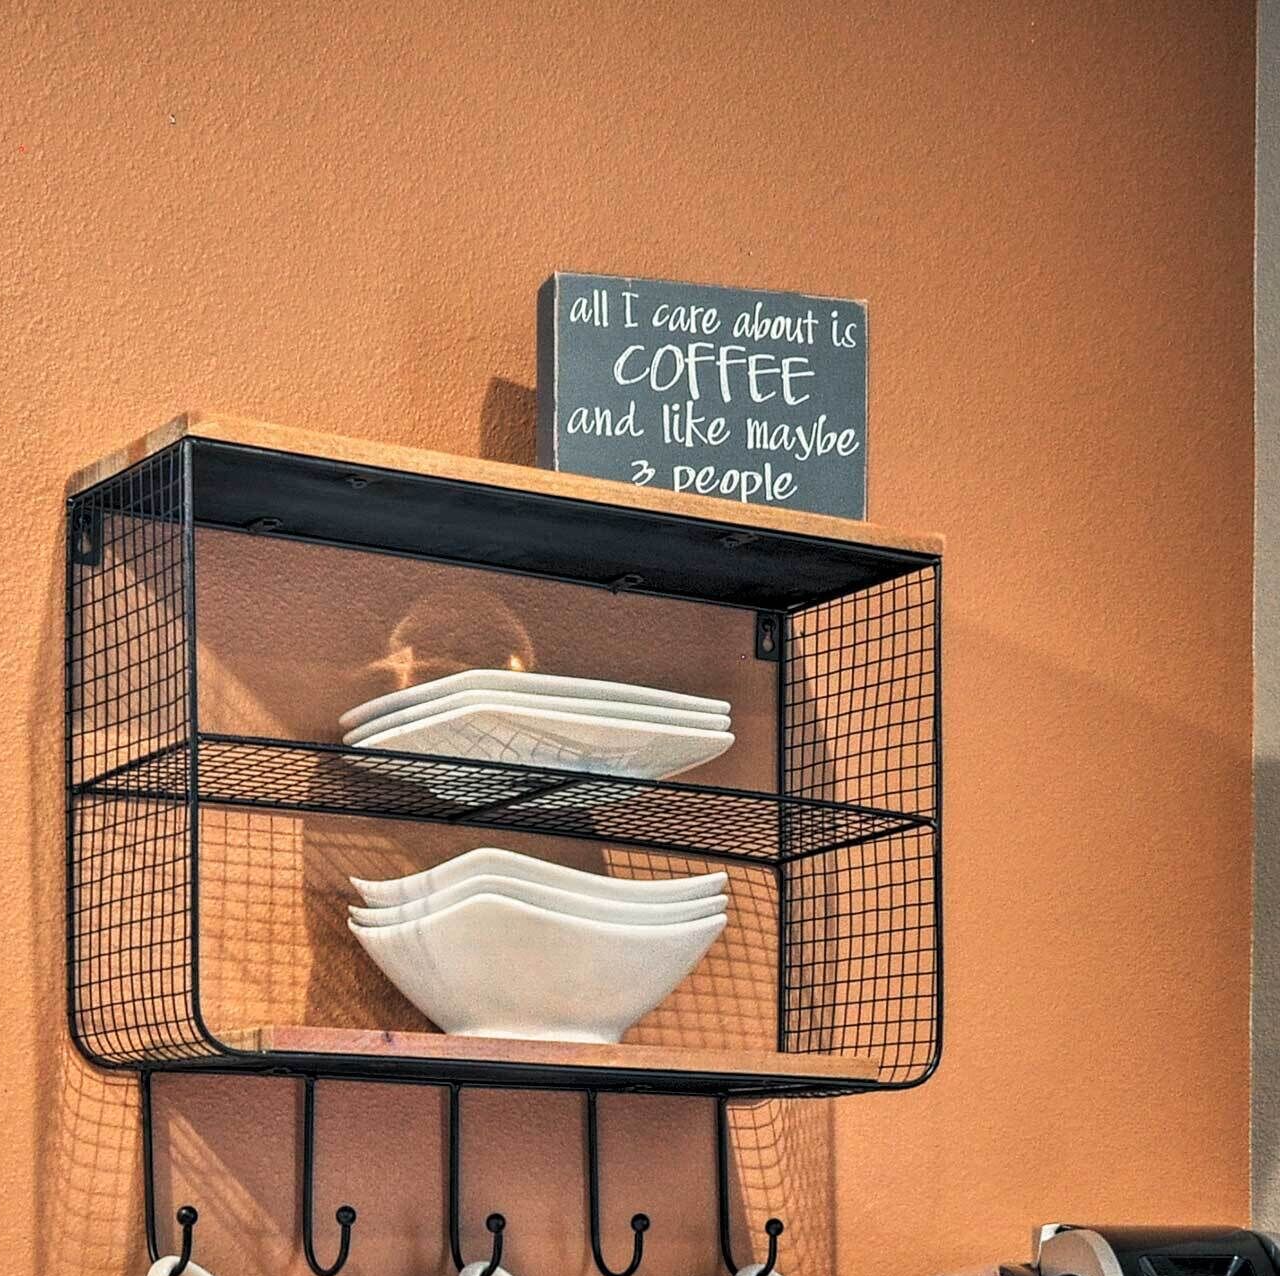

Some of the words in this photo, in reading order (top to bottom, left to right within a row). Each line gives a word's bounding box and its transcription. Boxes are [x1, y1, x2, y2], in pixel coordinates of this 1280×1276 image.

[570, 290, 608, 328] all
[622, 292, 638, 327] I
[652, 302, 719, 335] care
[732, 302, 819, 345] about
[831, 310, 857, 349] is
[613, 342, 815, 405] COFFEE
[567, 401, 644, 437] and
[662, 400, 730, 447] like
[745, 414, 860, 461] maybe
[630, 460, 655, 486] 3
[673, 463, 797, 503] people
